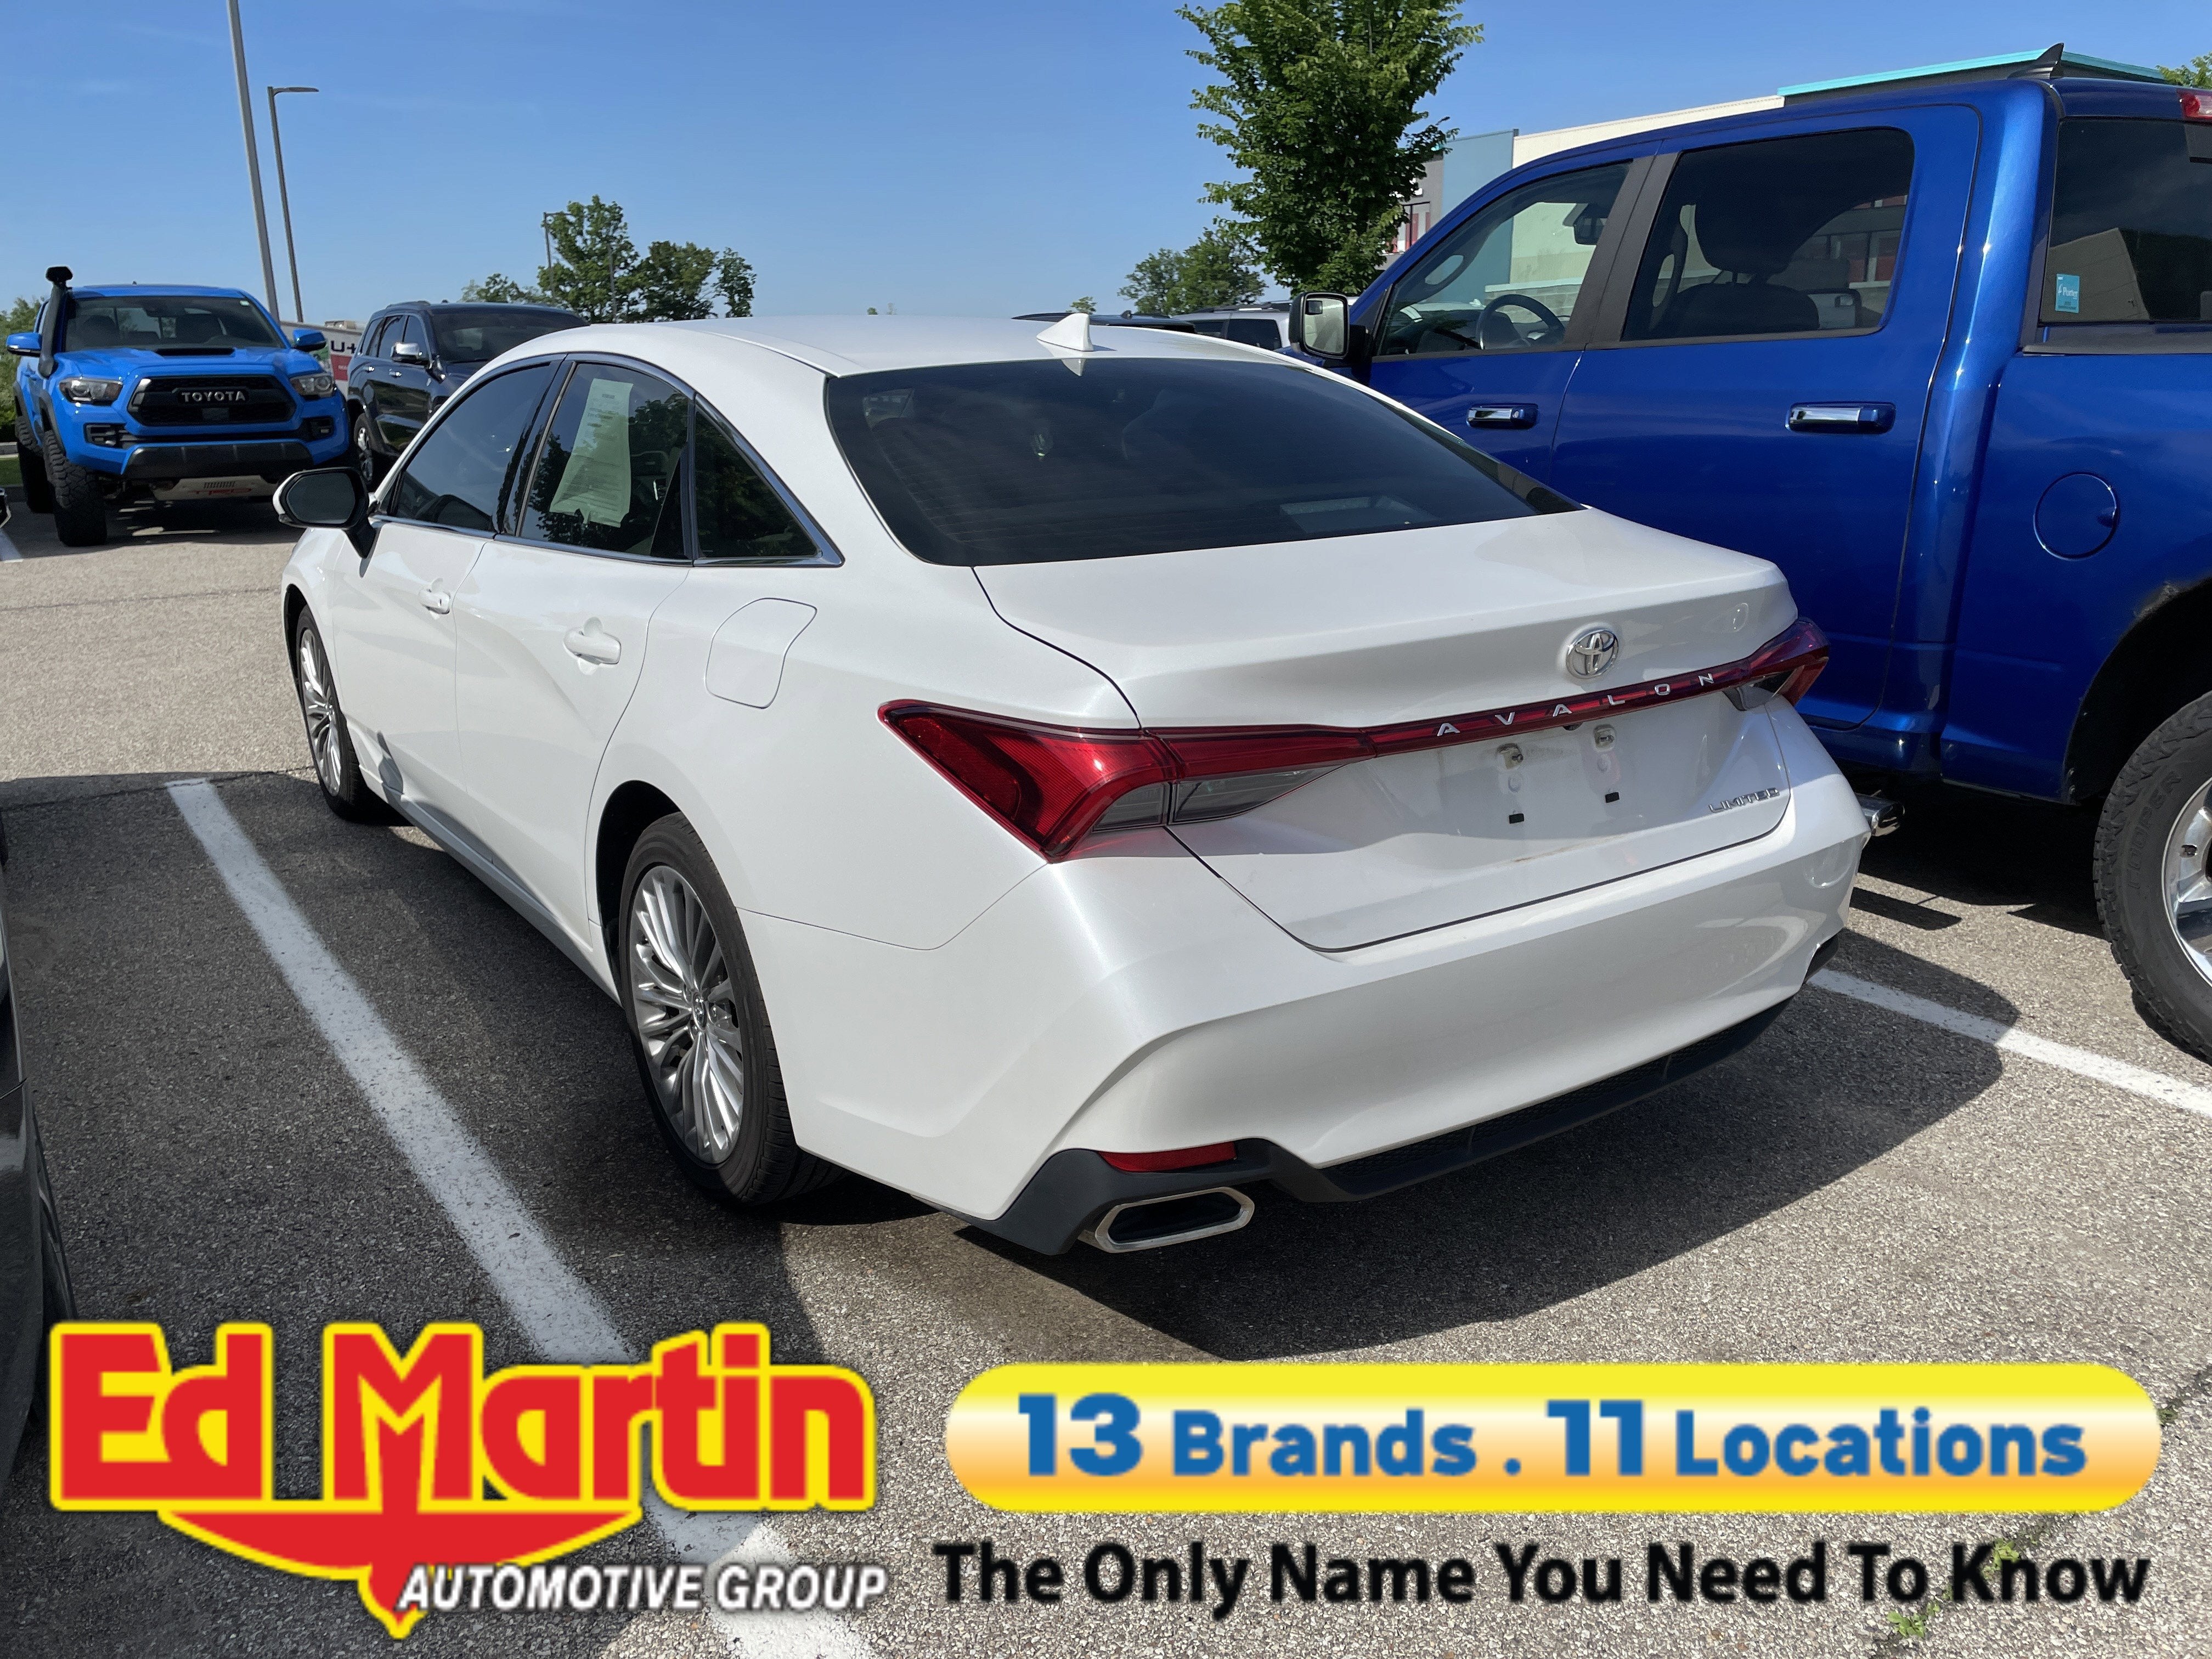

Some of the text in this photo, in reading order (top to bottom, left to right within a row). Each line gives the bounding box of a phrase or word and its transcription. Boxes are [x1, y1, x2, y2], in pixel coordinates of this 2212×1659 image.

[181, 391, 246, 403] TOYOTA
[1436, 673, 1715, 737] AVALON
[1708, 787, 1780, 813] LIMITED
